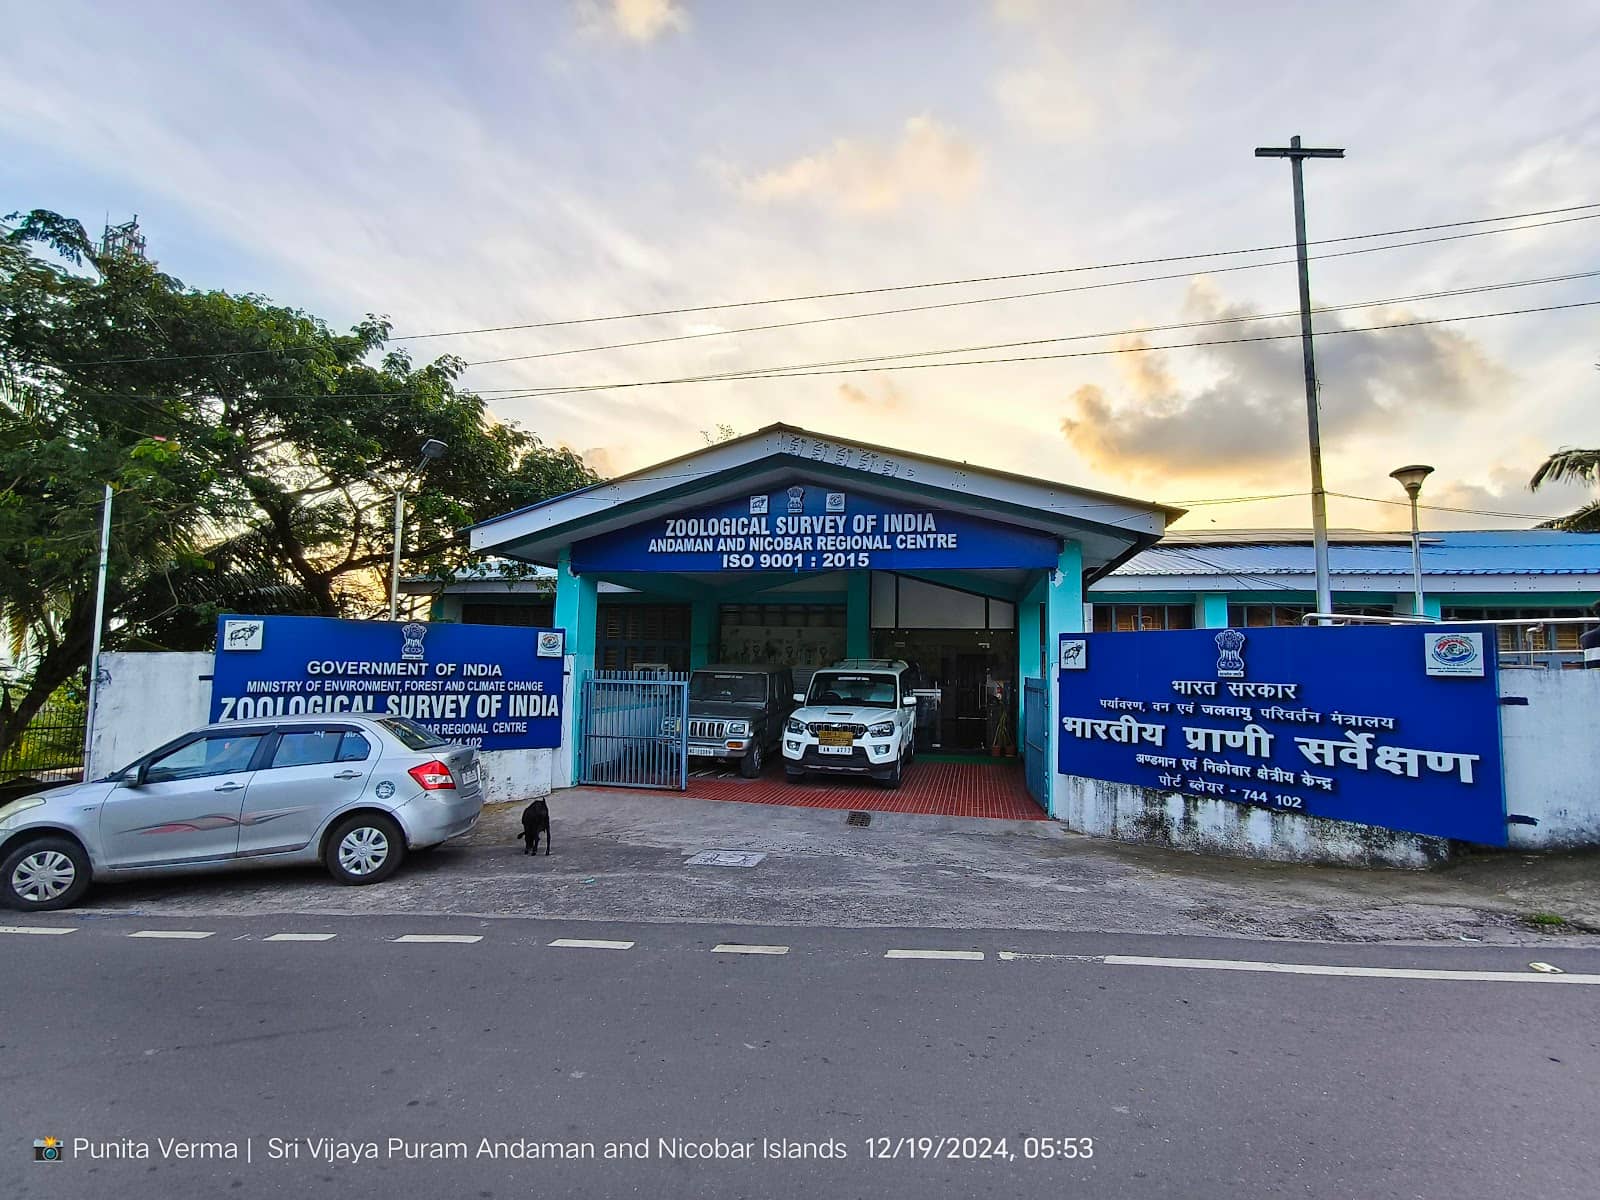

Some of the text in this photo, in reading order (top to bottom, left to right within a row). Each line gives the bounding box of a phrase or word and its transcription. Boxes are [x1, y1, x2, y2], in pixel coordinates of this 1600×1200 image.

[665, 513, 937, 537] ZOOLOGICAL SURVEY OF INDIA
[648, 533, 957, 553] ANDAMAN AND NICOBAR REGIONAL CENTRE
[722, 553, 755, 568] ISO
[759, 553, 803, 568] 9001
[822, 552, 869, 567] 2015
[307, 660, 502, 676] GOVERNMENT OF INDIA
[246, 680, 544, 694] MINISTRY OF ENVIRONMENT, FOREST AND CLIMATE CHANGE
[1171, 680, 1297, 699] भारत सरकार
[218, 694, 559, 722] ZOOLOGICAL SURVEY OF INDIA
[441, 723, 489, 735] REGIONAL
[492, 721, 528, 733] CENTRE
[1062, 714, 1480, 784] भारतीय प्राणी सर्वेक्षण
[1135, 753, 1333, 791] अण्डमान एवं निकोबार क्षेत्रीय केन्द्र
[1158, 772, 1181, 787] पोर्ट
[1188, 776, 1224, 794] ब्लेयर
[1242, 789, 1268, 803] 744
[1275, 794, 1303, 809] 102
